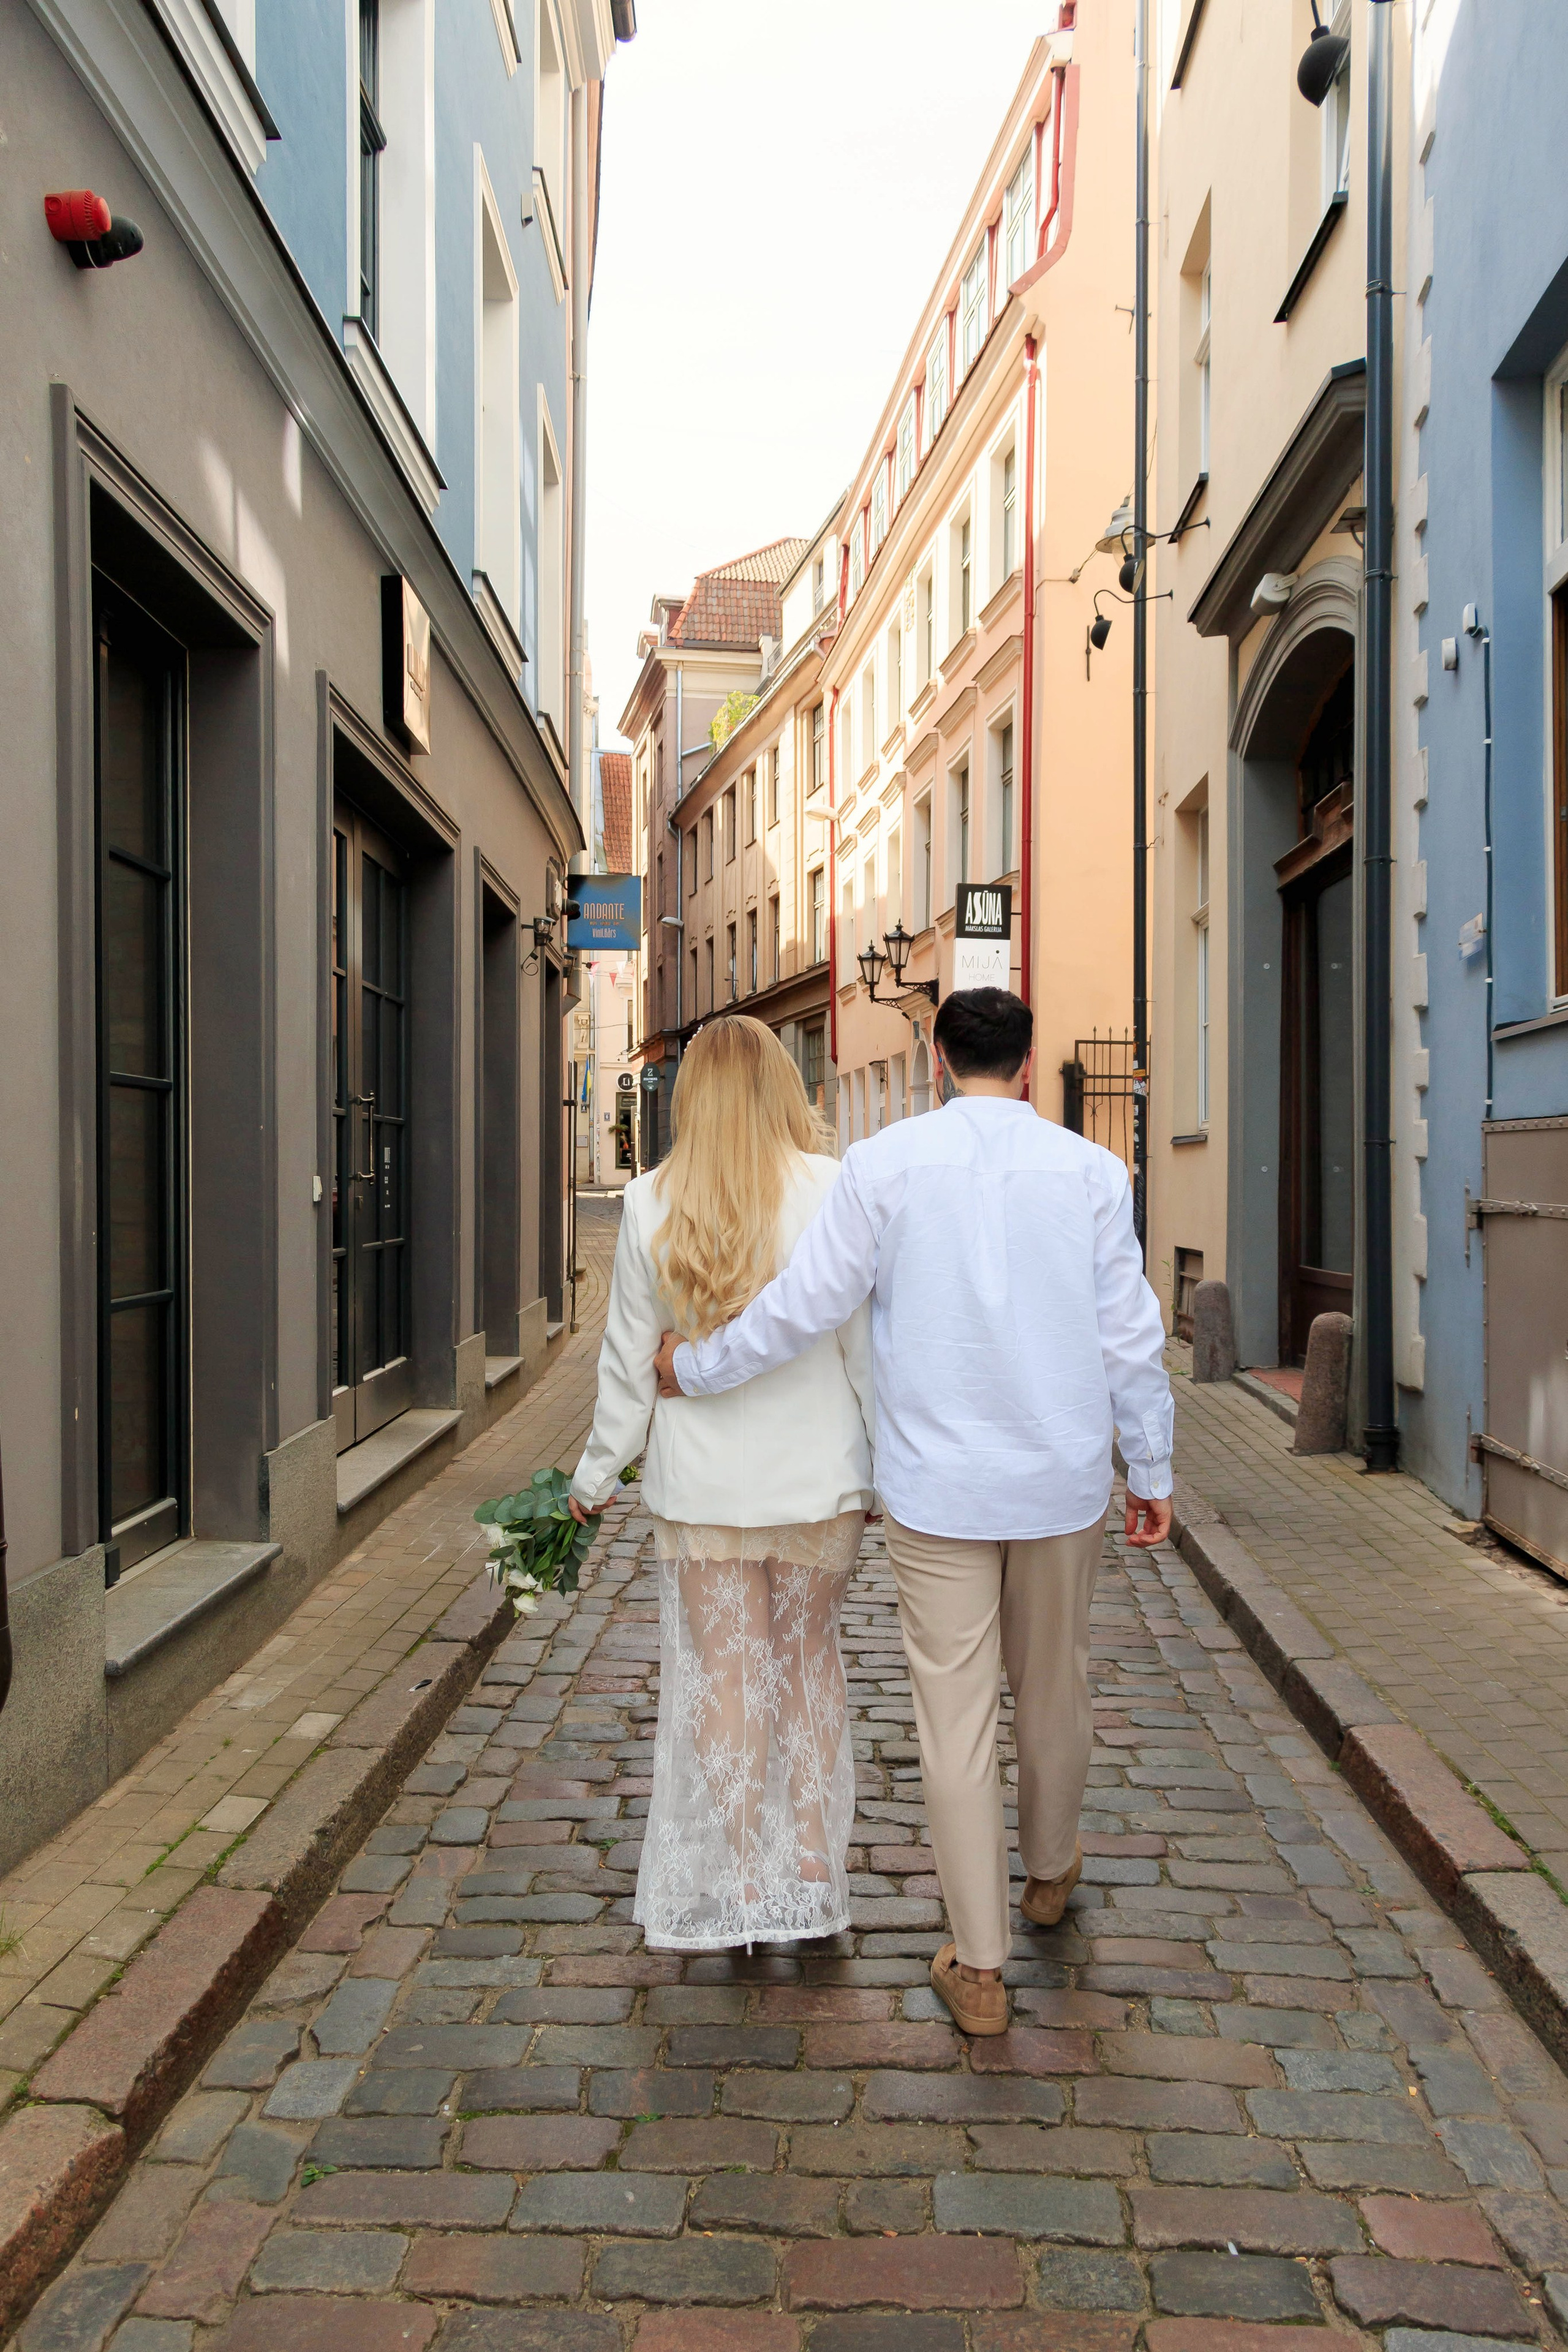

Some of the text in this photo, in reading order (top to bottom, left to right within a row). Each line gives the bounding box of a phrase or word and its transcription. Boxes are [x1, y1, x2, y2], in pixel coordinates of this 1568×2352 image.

[584, 903, 625, 919] ANDANTE
[965, 890, 1002, 925] ASŪNA
[968, 973, 995, 982] HOME
[647, 1068, 654, 1076] Z
